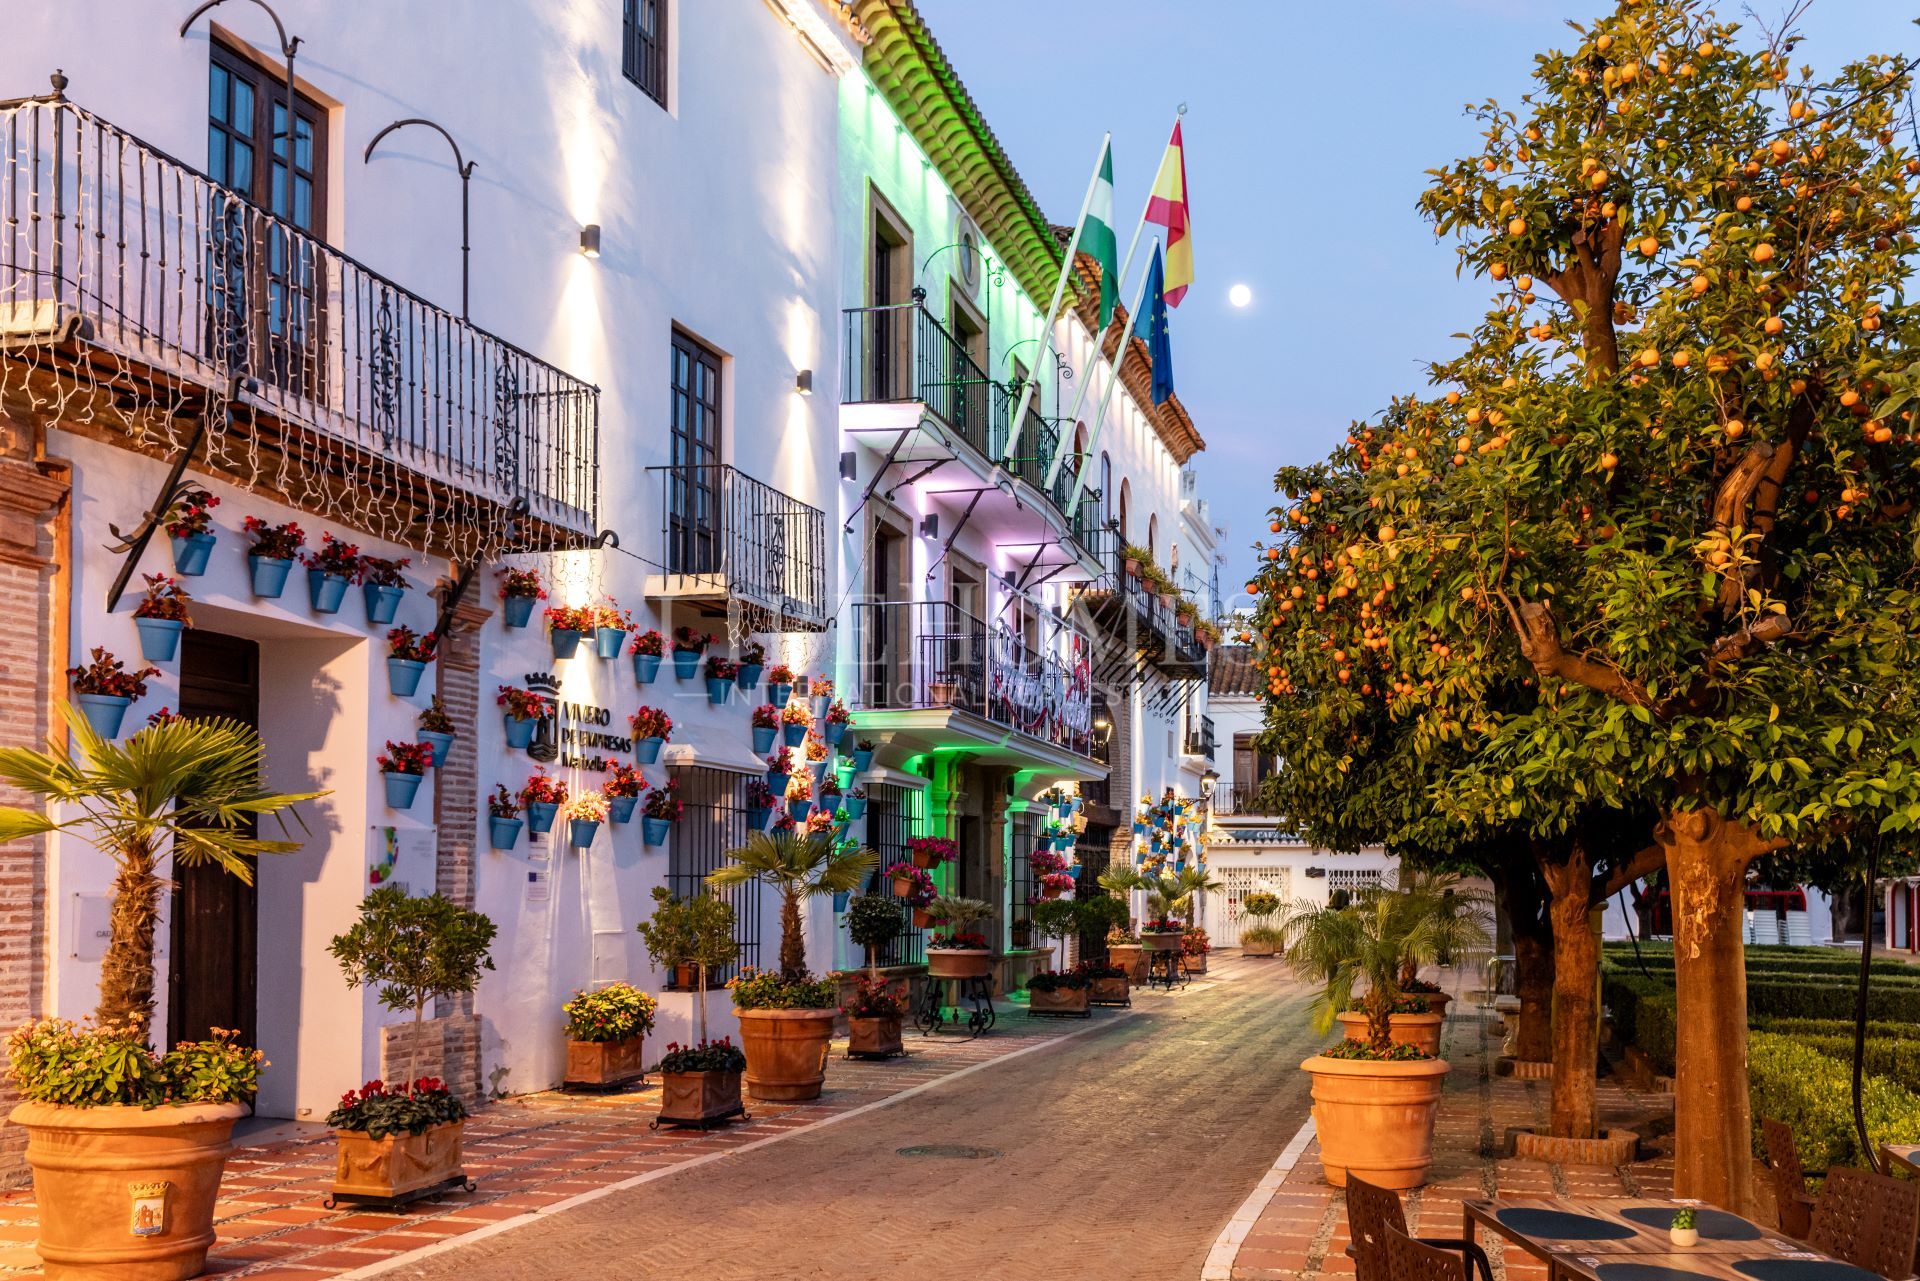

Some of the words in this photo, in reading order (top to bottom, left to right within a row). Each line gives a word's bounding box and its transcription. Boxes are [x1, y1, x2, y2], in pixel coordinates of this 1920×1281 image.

[563, 701, 611, 727] VIVERO
[561, 727, 578, 745] DE
[579, 730, 632, 754] EMPRESAS
